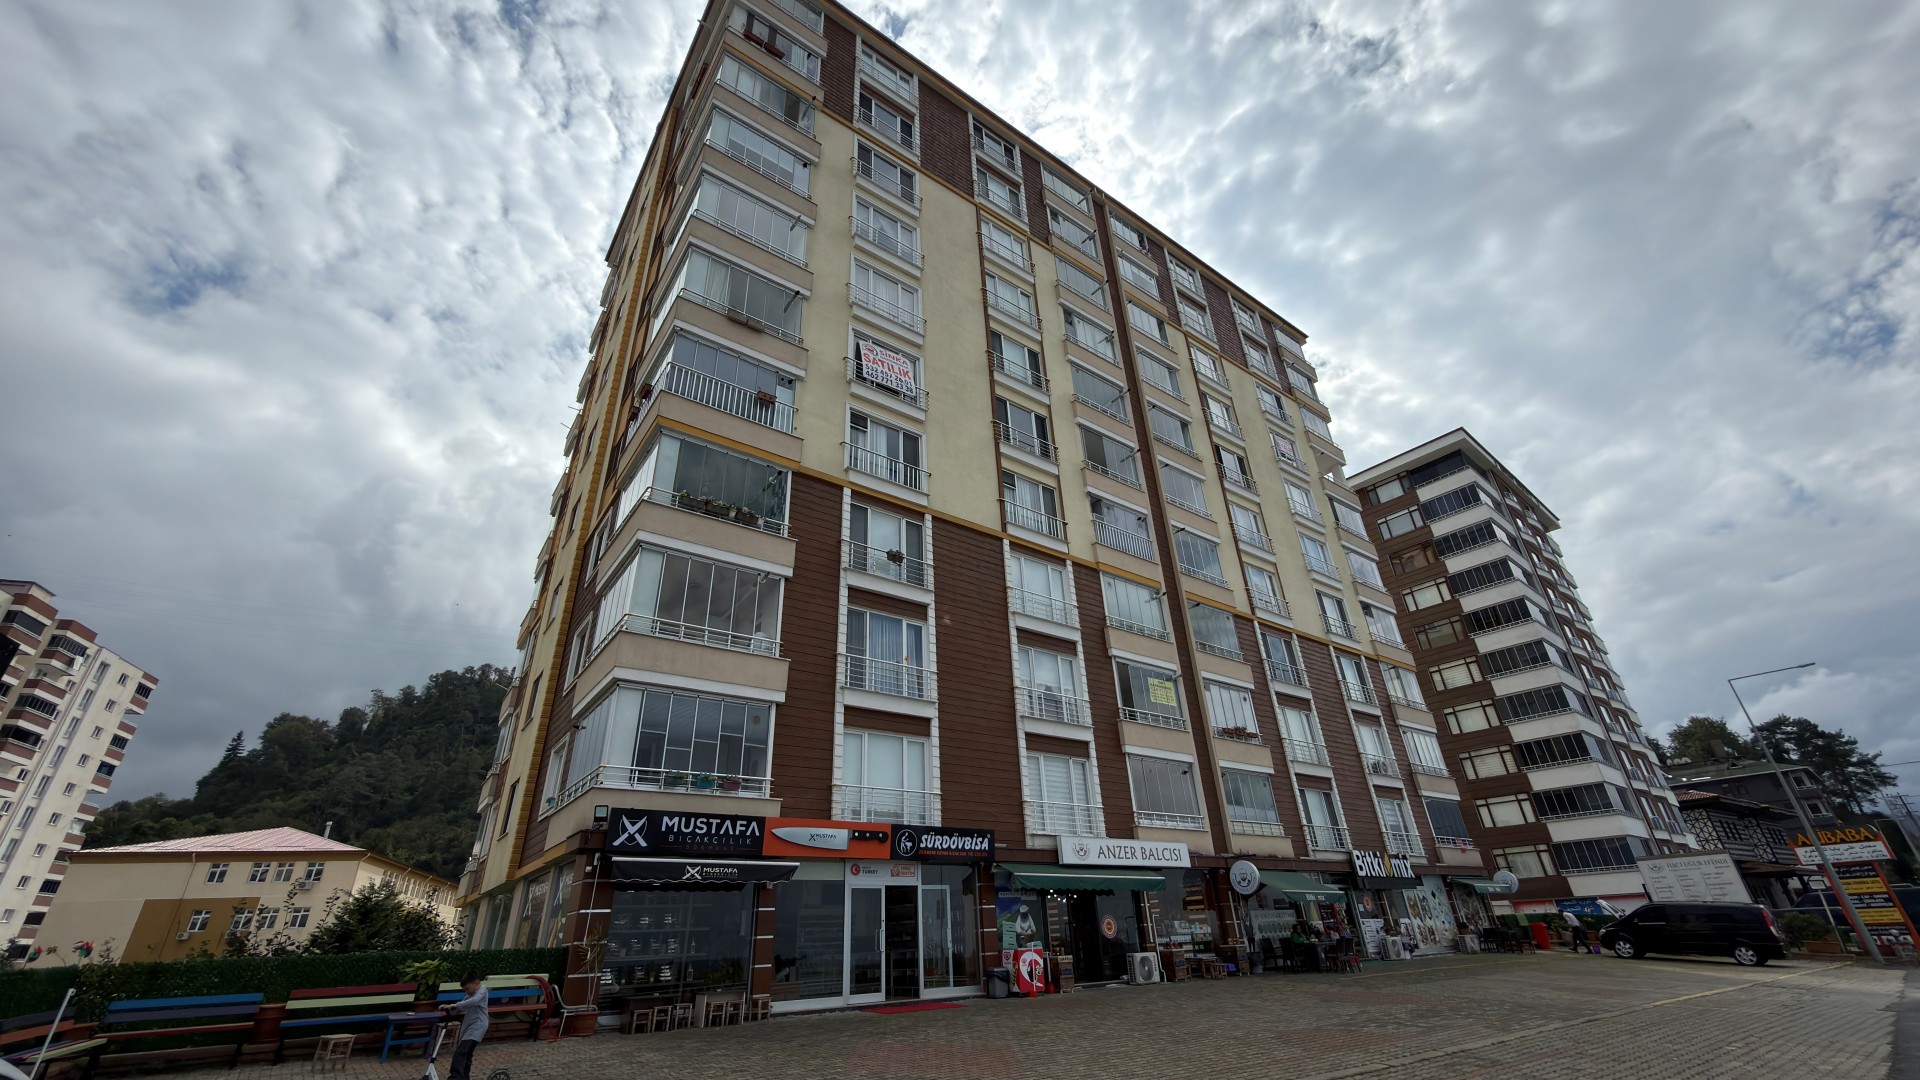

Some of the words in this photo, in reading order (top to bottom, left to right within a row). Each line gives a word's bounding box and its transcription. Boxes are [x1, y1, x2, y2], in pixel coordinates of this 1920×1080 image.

[863, 353, 911, 380] SATILIK
[865, 371, 879, 380] 462
[880, 376, 893, 385] 771
[661, 815, 760, 837] MUSTAFA
[919, 832, 989, 851] SÜRDÖVBİSA
[1097, 845, 1138, 860] ANZER
[1140, 847, 1183, 862] BALCISI
[1353, 850, 1386, 877] Bitki
[1389, 855, 1416, 879] mix
